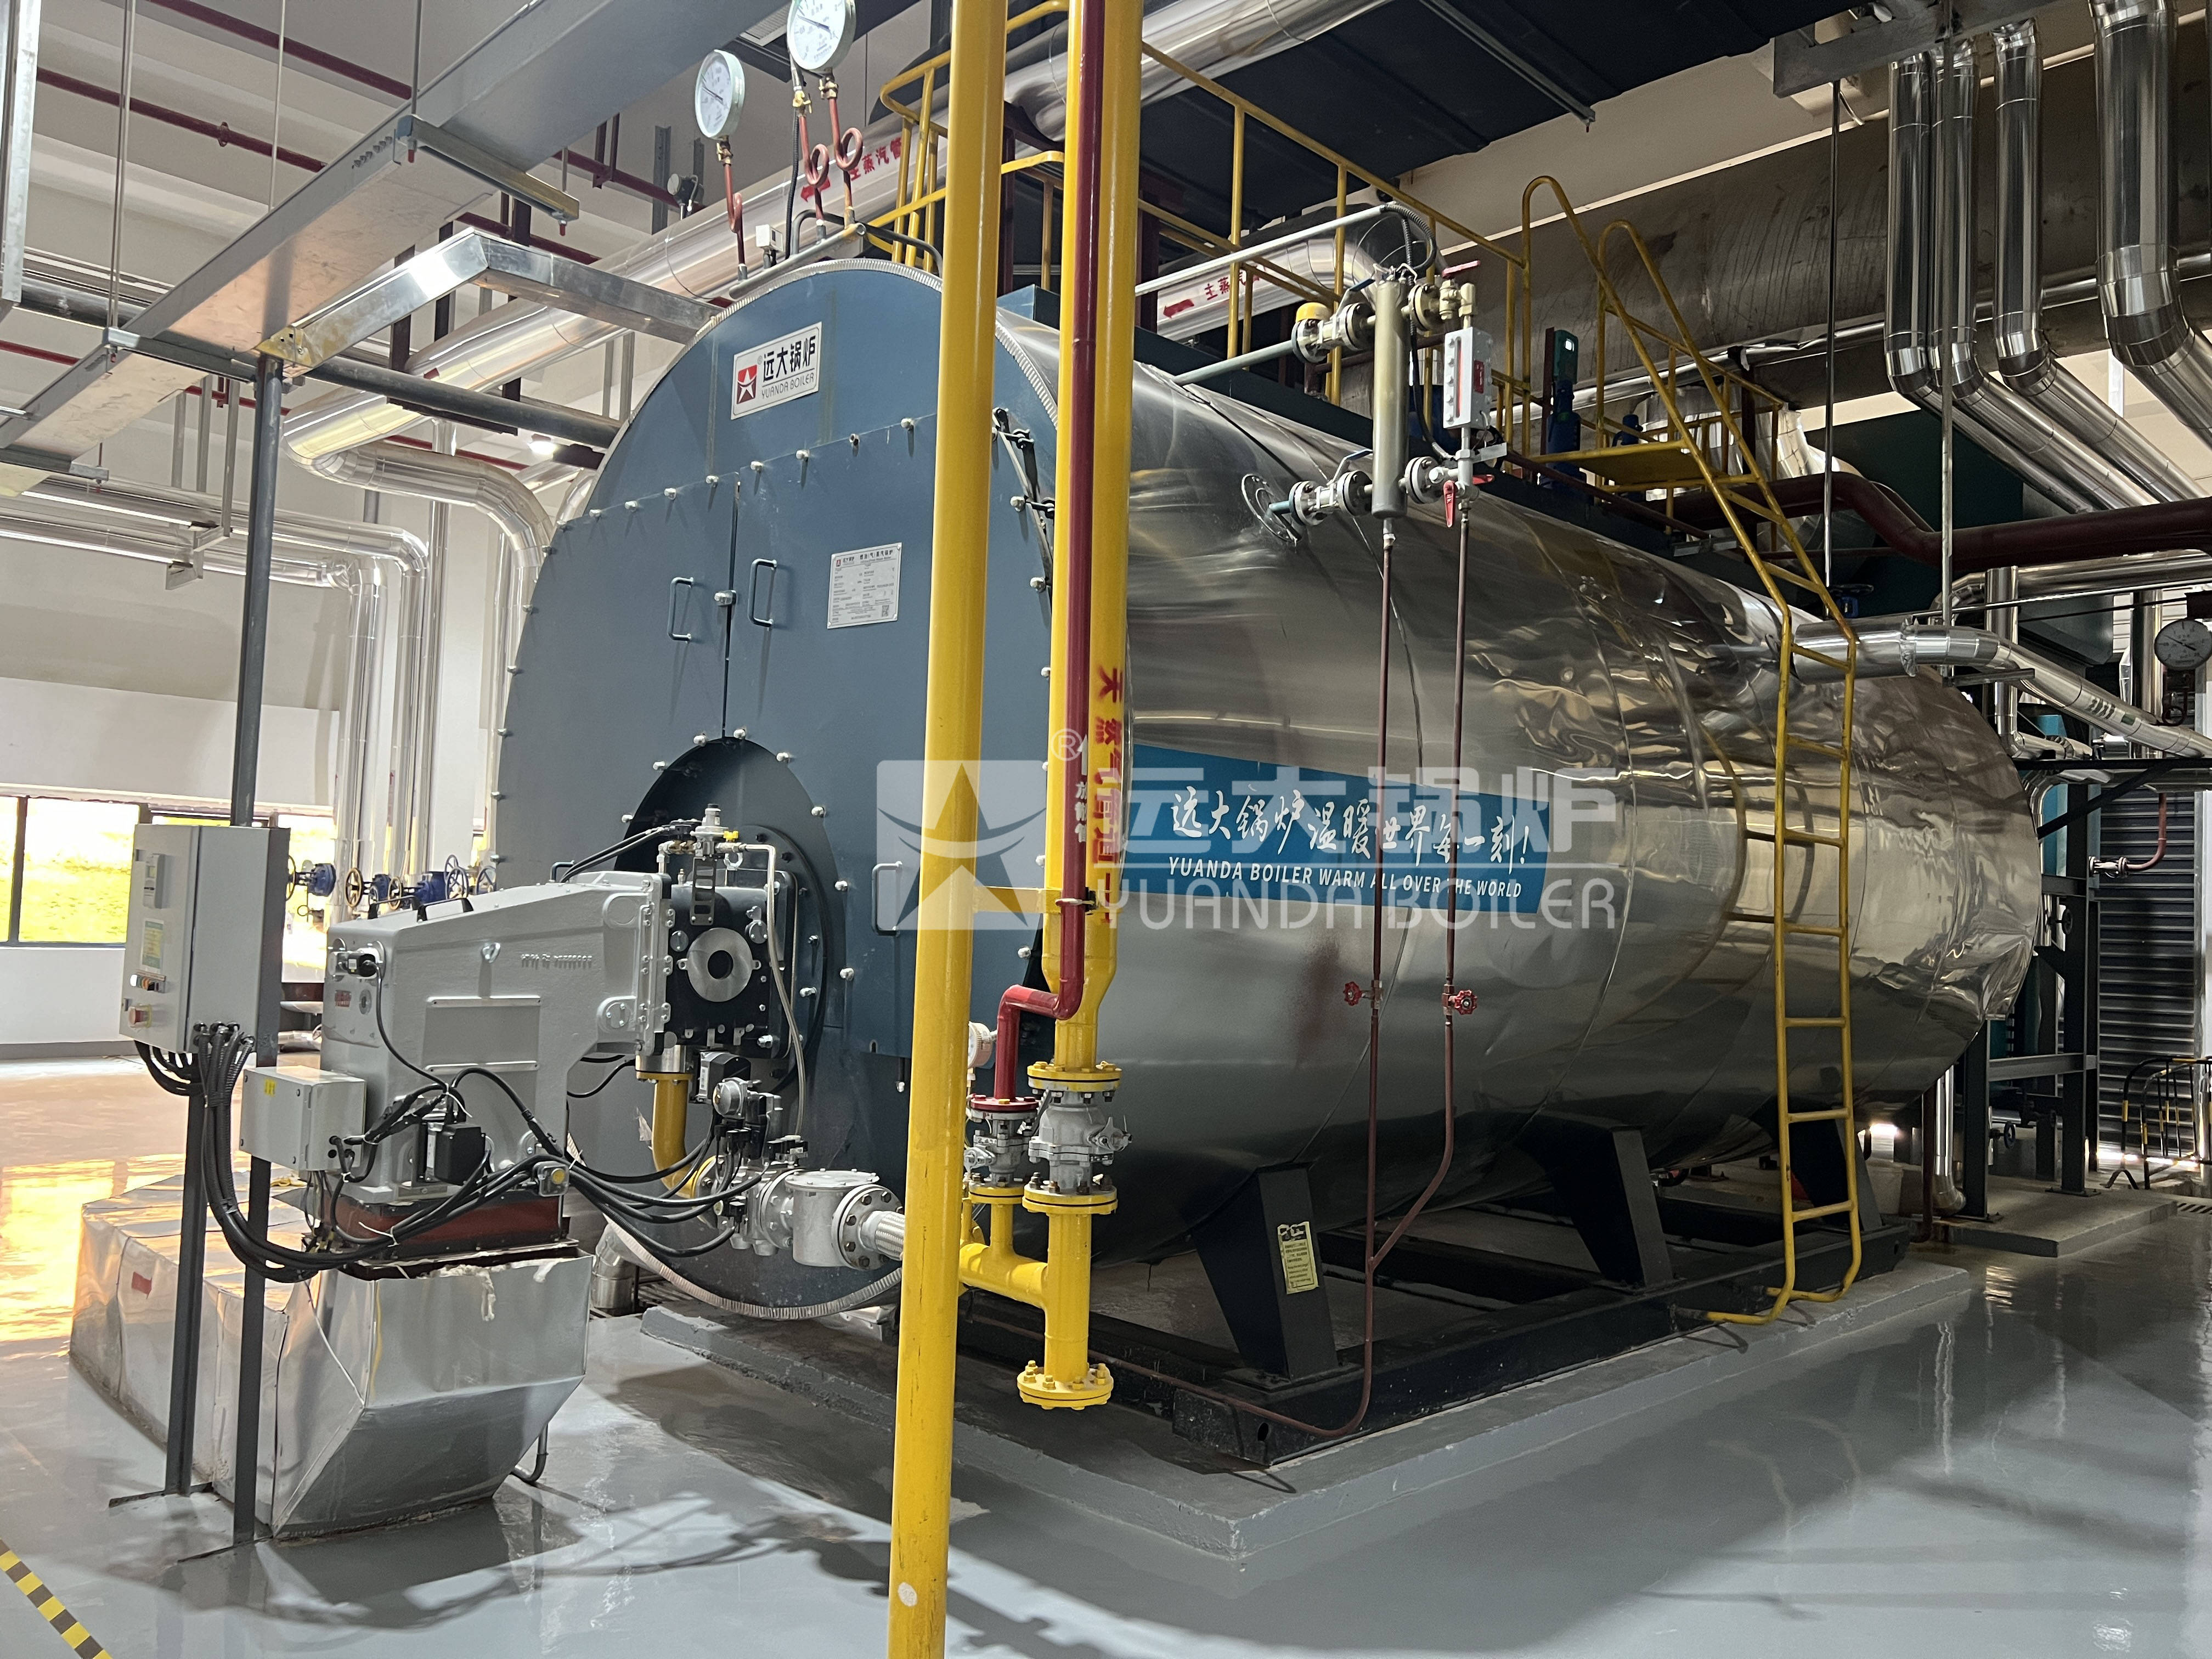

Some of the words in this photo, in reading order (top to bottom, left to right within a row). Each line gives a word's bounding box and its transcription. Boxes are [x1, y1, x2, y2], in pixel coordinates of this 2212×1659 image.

[763, 335, 816, 382] 远大锅炉
[761, 381, 788, 399] YUANDA
[790, 373, 815, 390] BOILER
[1169, 856, 1242, 880] YUANDA
[1250, 862, 1313, 885] BOILER
[1318, 868, 1365, 888] WARM
[1402, 874, 1440, 894] OVER
[1447, 878, 1470, 895] HE
[1476, 879, 1522, 898] WORLD
